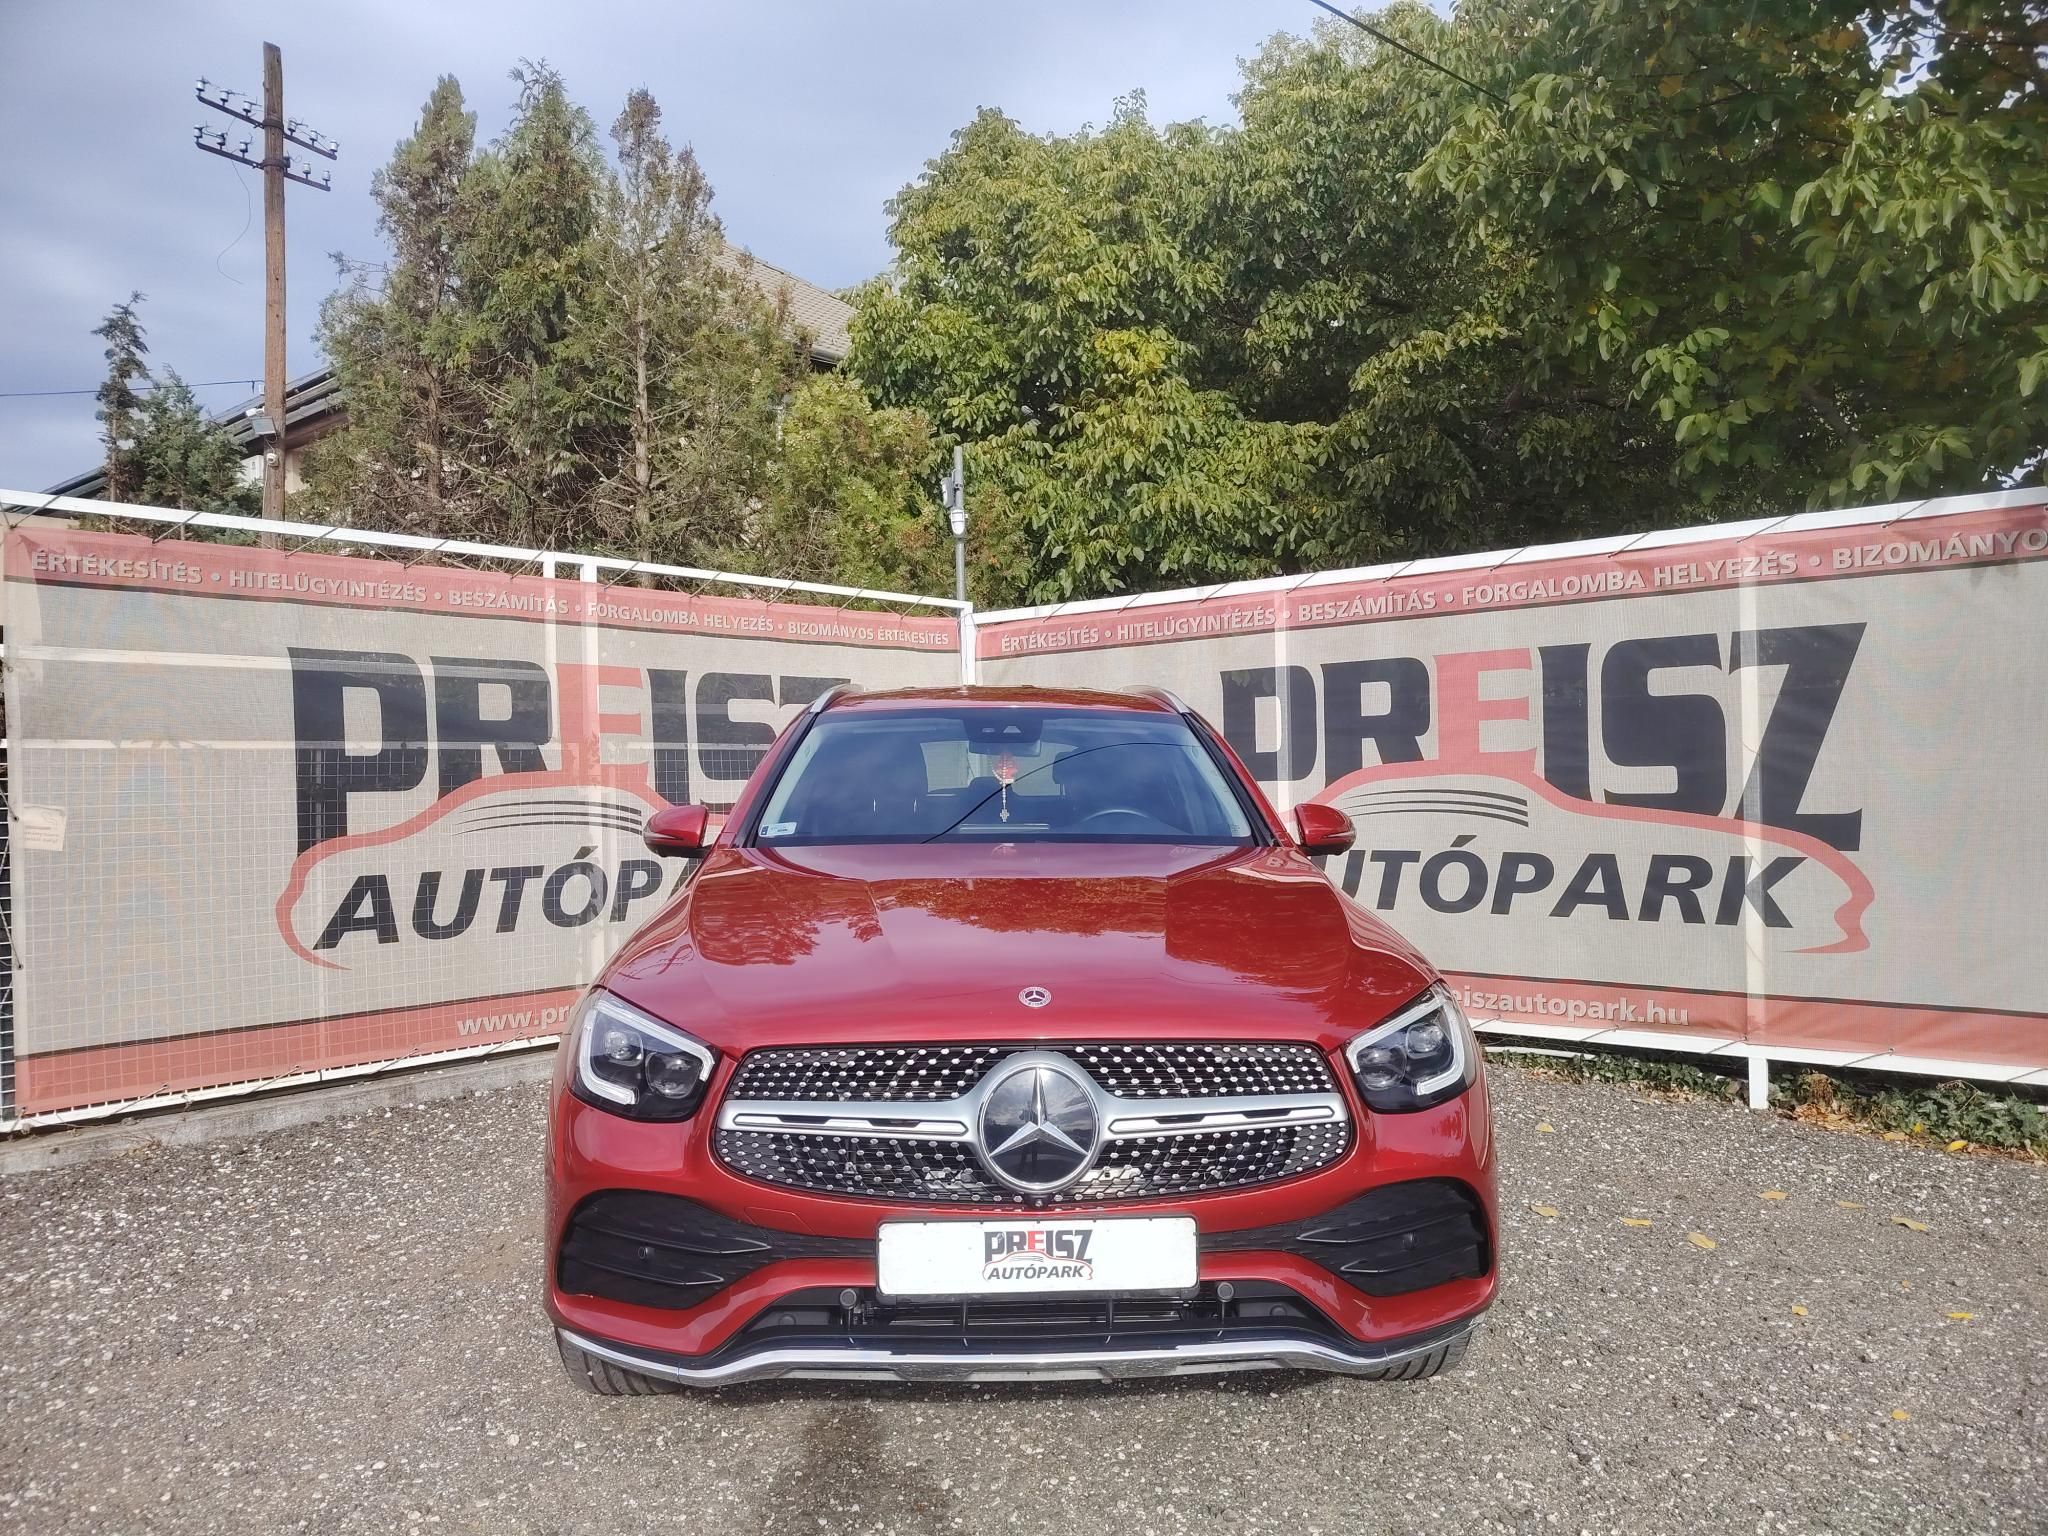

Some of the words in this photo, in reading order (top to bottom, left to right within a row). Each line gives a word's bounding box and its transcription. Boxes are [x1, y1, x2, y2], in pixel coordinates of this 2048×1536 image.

[31, 549, 203, 584] ÉRTÉKESÍTÉS
[229, 569, 427, 602] HITELÜGYINTÉZÉS
[449, 590, 569, 614] BESZÁMÍTÁS
[587, 602, 700, 627] FORGALOMBA
[704, 611, 774, 633] HELYEZÉS
[788, 621, 874, 642] BIZOMÁNYOS
[877, 627, 949, 646] ÉRTÉKESÍTÉS
[1001, 626, 1099, 653] ÉRTÉKESÍTÉS
[1117, 607, 1276, 641] HITELÜGYINTÉZÉS
[1299, 589, 1437, 623] BESZÁMÍTÁS
[1462, 570, 1646, 606] FORGALOMBA
[1655, 550, 1798, 587] HELYEZÉS
[1832, 528, 2048, 570] BIZOMÁNYO
[287, 646, 852, 857] PREIS
[312, 845, 702, 950] AUTÓP
[1310, 833, 1809, 929] UTÓPARK
[984, 1229, 1093, 1264] PREISZ
[988, 1264, 1085, 1281] AUTÓPARK
